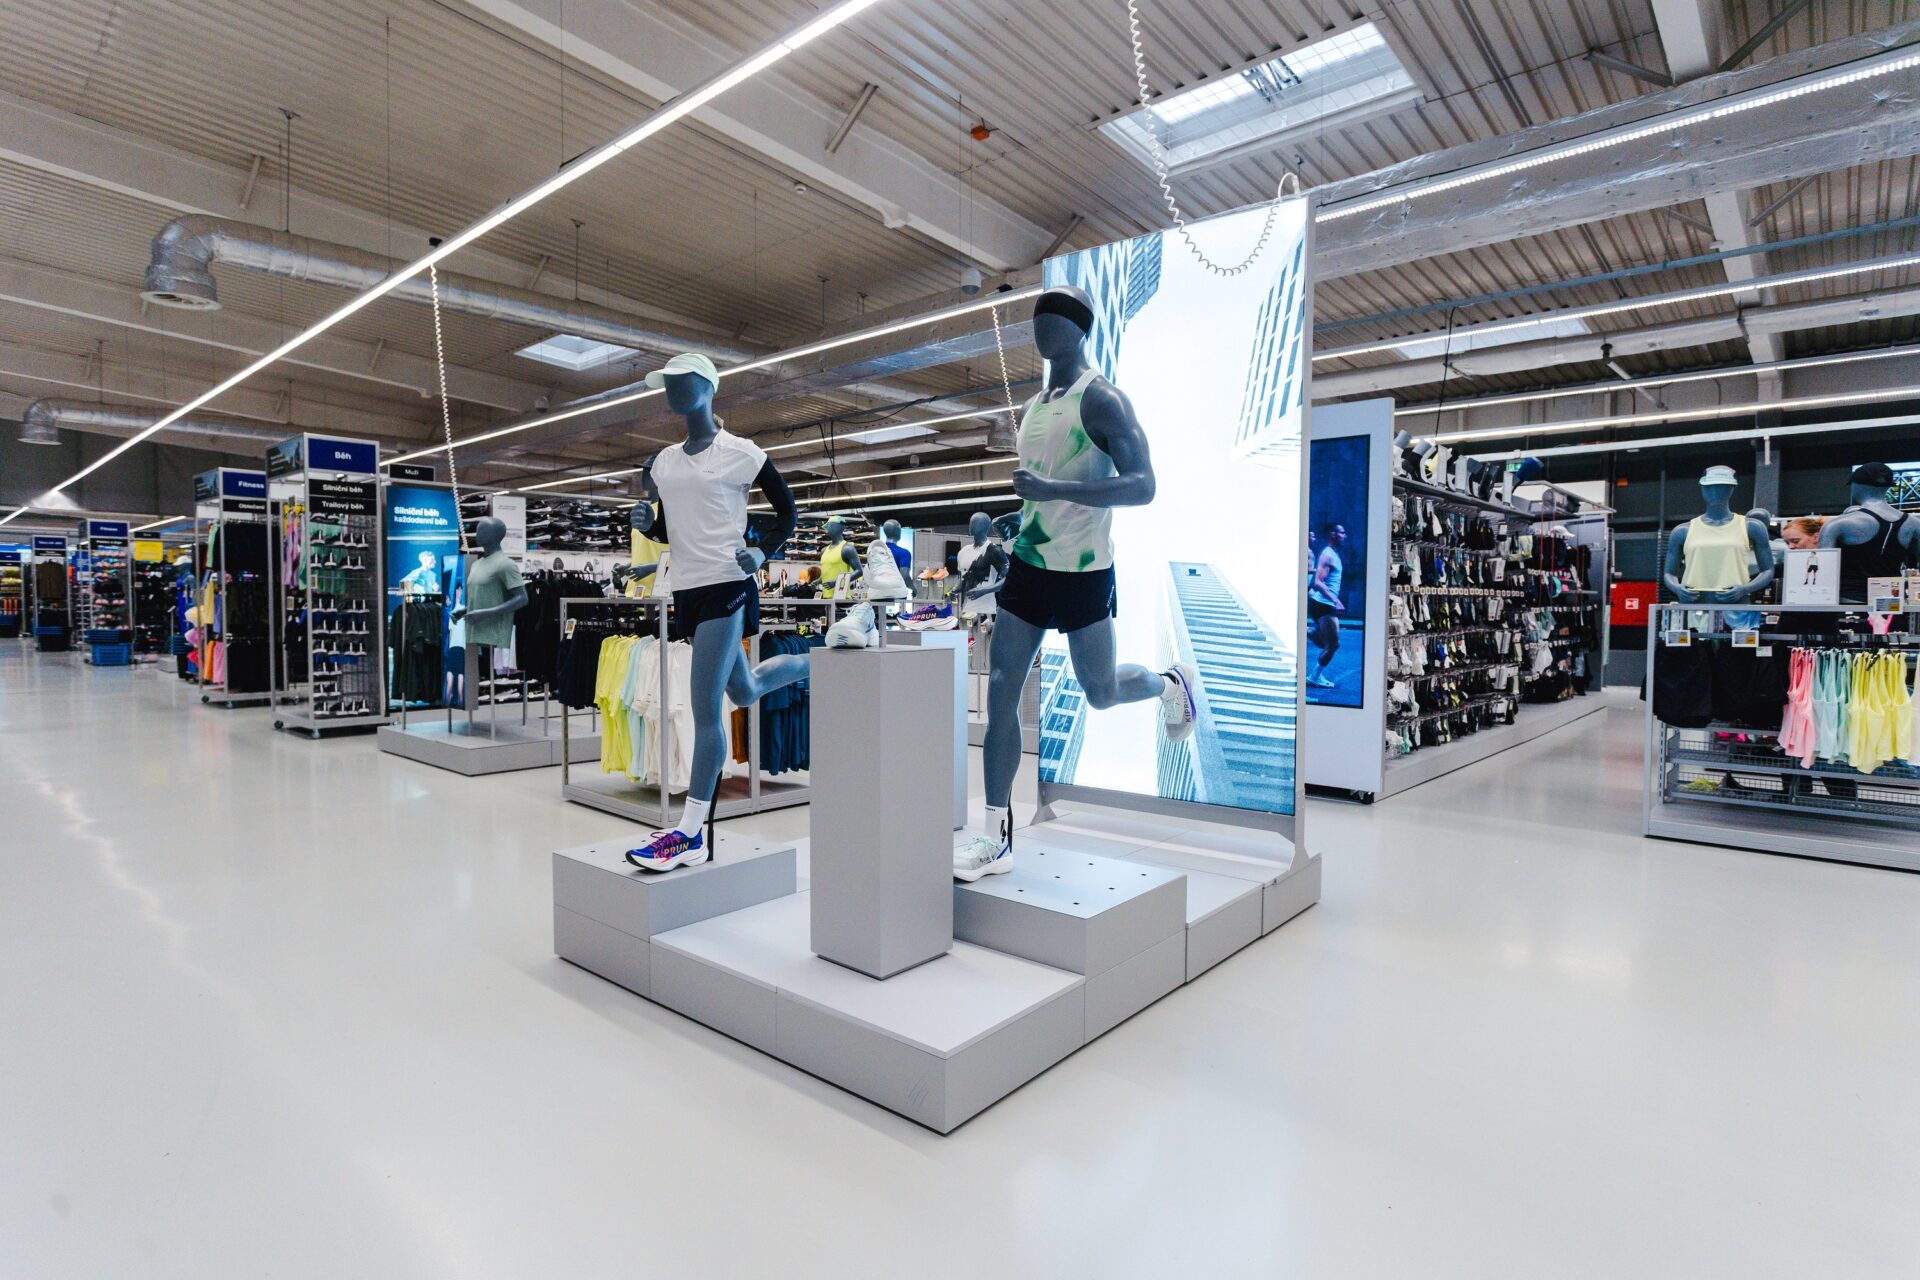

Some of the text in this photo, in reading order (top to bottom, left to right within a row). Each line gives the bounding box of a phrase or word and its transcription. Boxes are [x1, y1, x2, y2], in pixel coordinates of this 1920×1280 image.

[334, 451, 352, 461] Běh
[238, 480, 265, 490] Fitness
[322, 483, 363, 494] Silniční běh
[321, 500, 365, 511] Trailový běh
[393, 505, 440, 517] Silniční běh
[393, 515, 449, 526] každodenní běh
[652, 842, 690, 859] KPRUN
